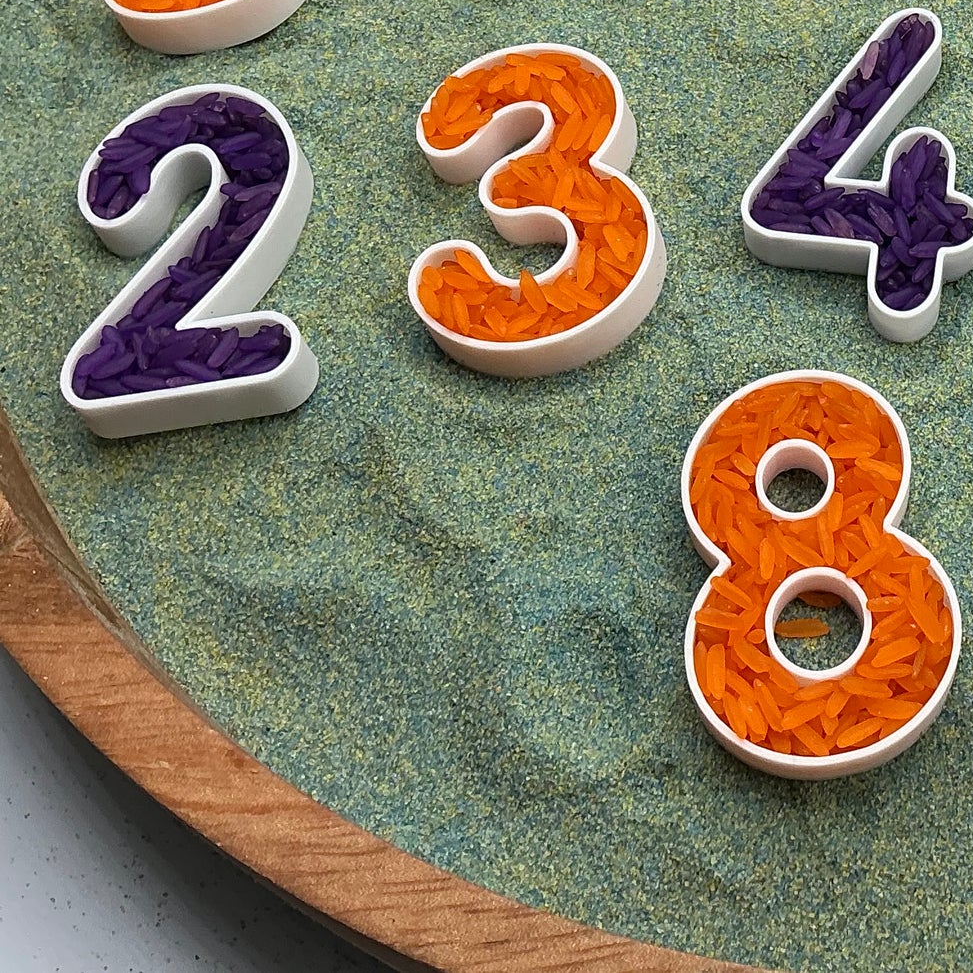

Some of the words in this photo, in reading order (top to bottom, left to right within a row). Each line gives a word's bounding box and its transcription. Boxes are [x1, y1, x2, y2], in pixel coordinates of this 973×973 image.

[62, 84, 315, 439] 2
[409, 43, 667, 374] 3
[683, 369, 962, 776] 8
